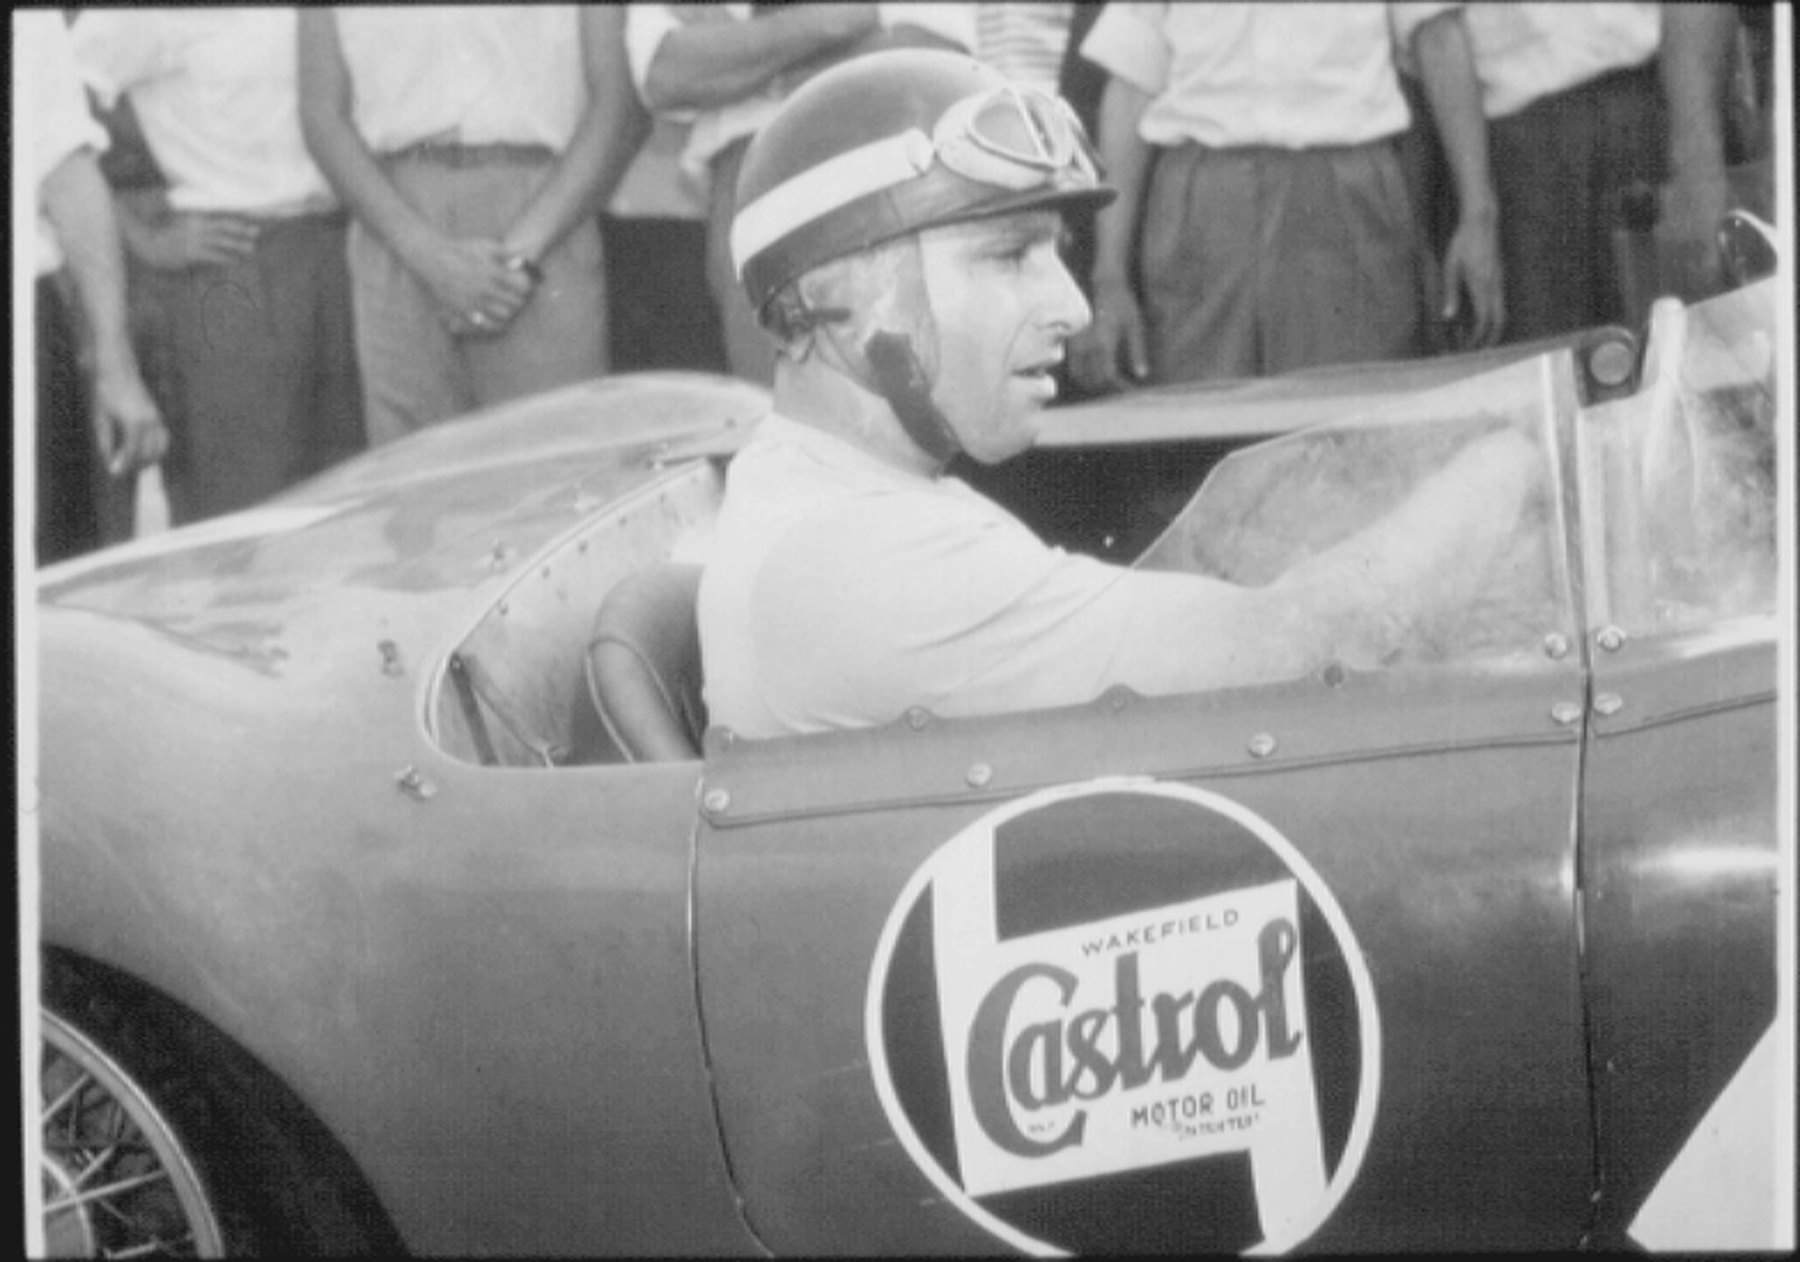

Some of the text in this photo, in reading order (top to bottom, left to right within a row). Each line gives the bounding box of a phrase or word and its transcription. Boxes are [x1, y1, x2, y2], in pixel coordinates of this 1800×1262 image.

[1082, 909, 1239, 956] WAKEFIELD
[966, 917, 1302, 1158] Castrol
[1132, 1083, 1266, 1129] MOTOR OIL
